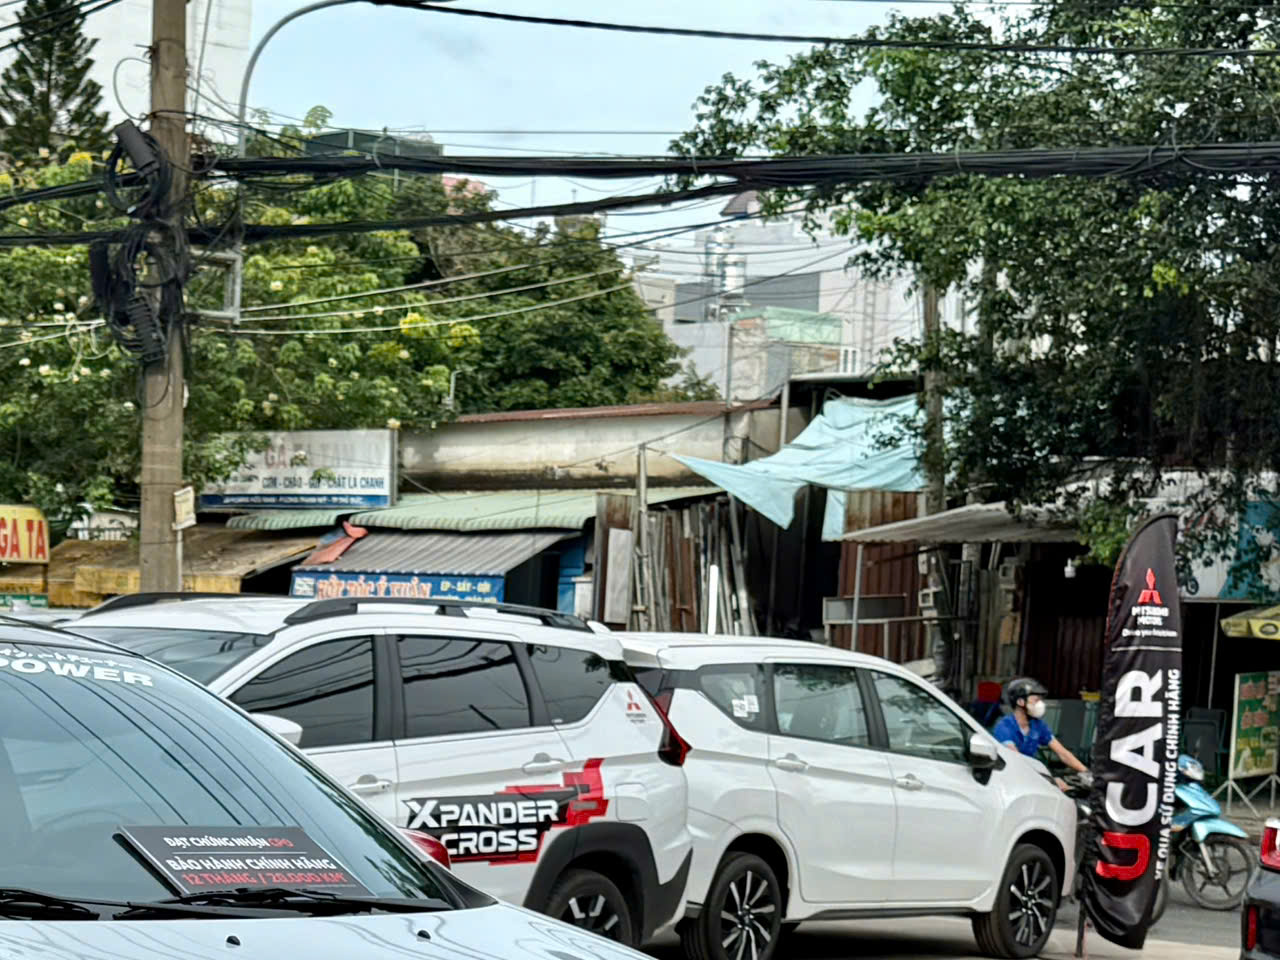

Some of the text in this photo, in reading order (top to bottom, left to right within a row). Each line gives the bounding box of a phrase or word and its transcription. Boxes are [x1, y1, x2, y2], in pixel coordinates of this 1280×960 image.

[26, 519, 47, 560] TA
[1164, 669, 1180, 715] HÃNG
[408, 799, 559, 828] XPANDER
[164, 836, 189, 849] ĐẠT
[190, 834, 235, 847] CHỨNG
[234, 835, 271, 848] NHẬN
[440, 828, 539, 855] CROSS
[166, 856, 337, 871] BẢO HÀNH CHÍNH HÃNG
[182, 874, 203, 885] 12
[202, 872, 257, 885] THÁNG
